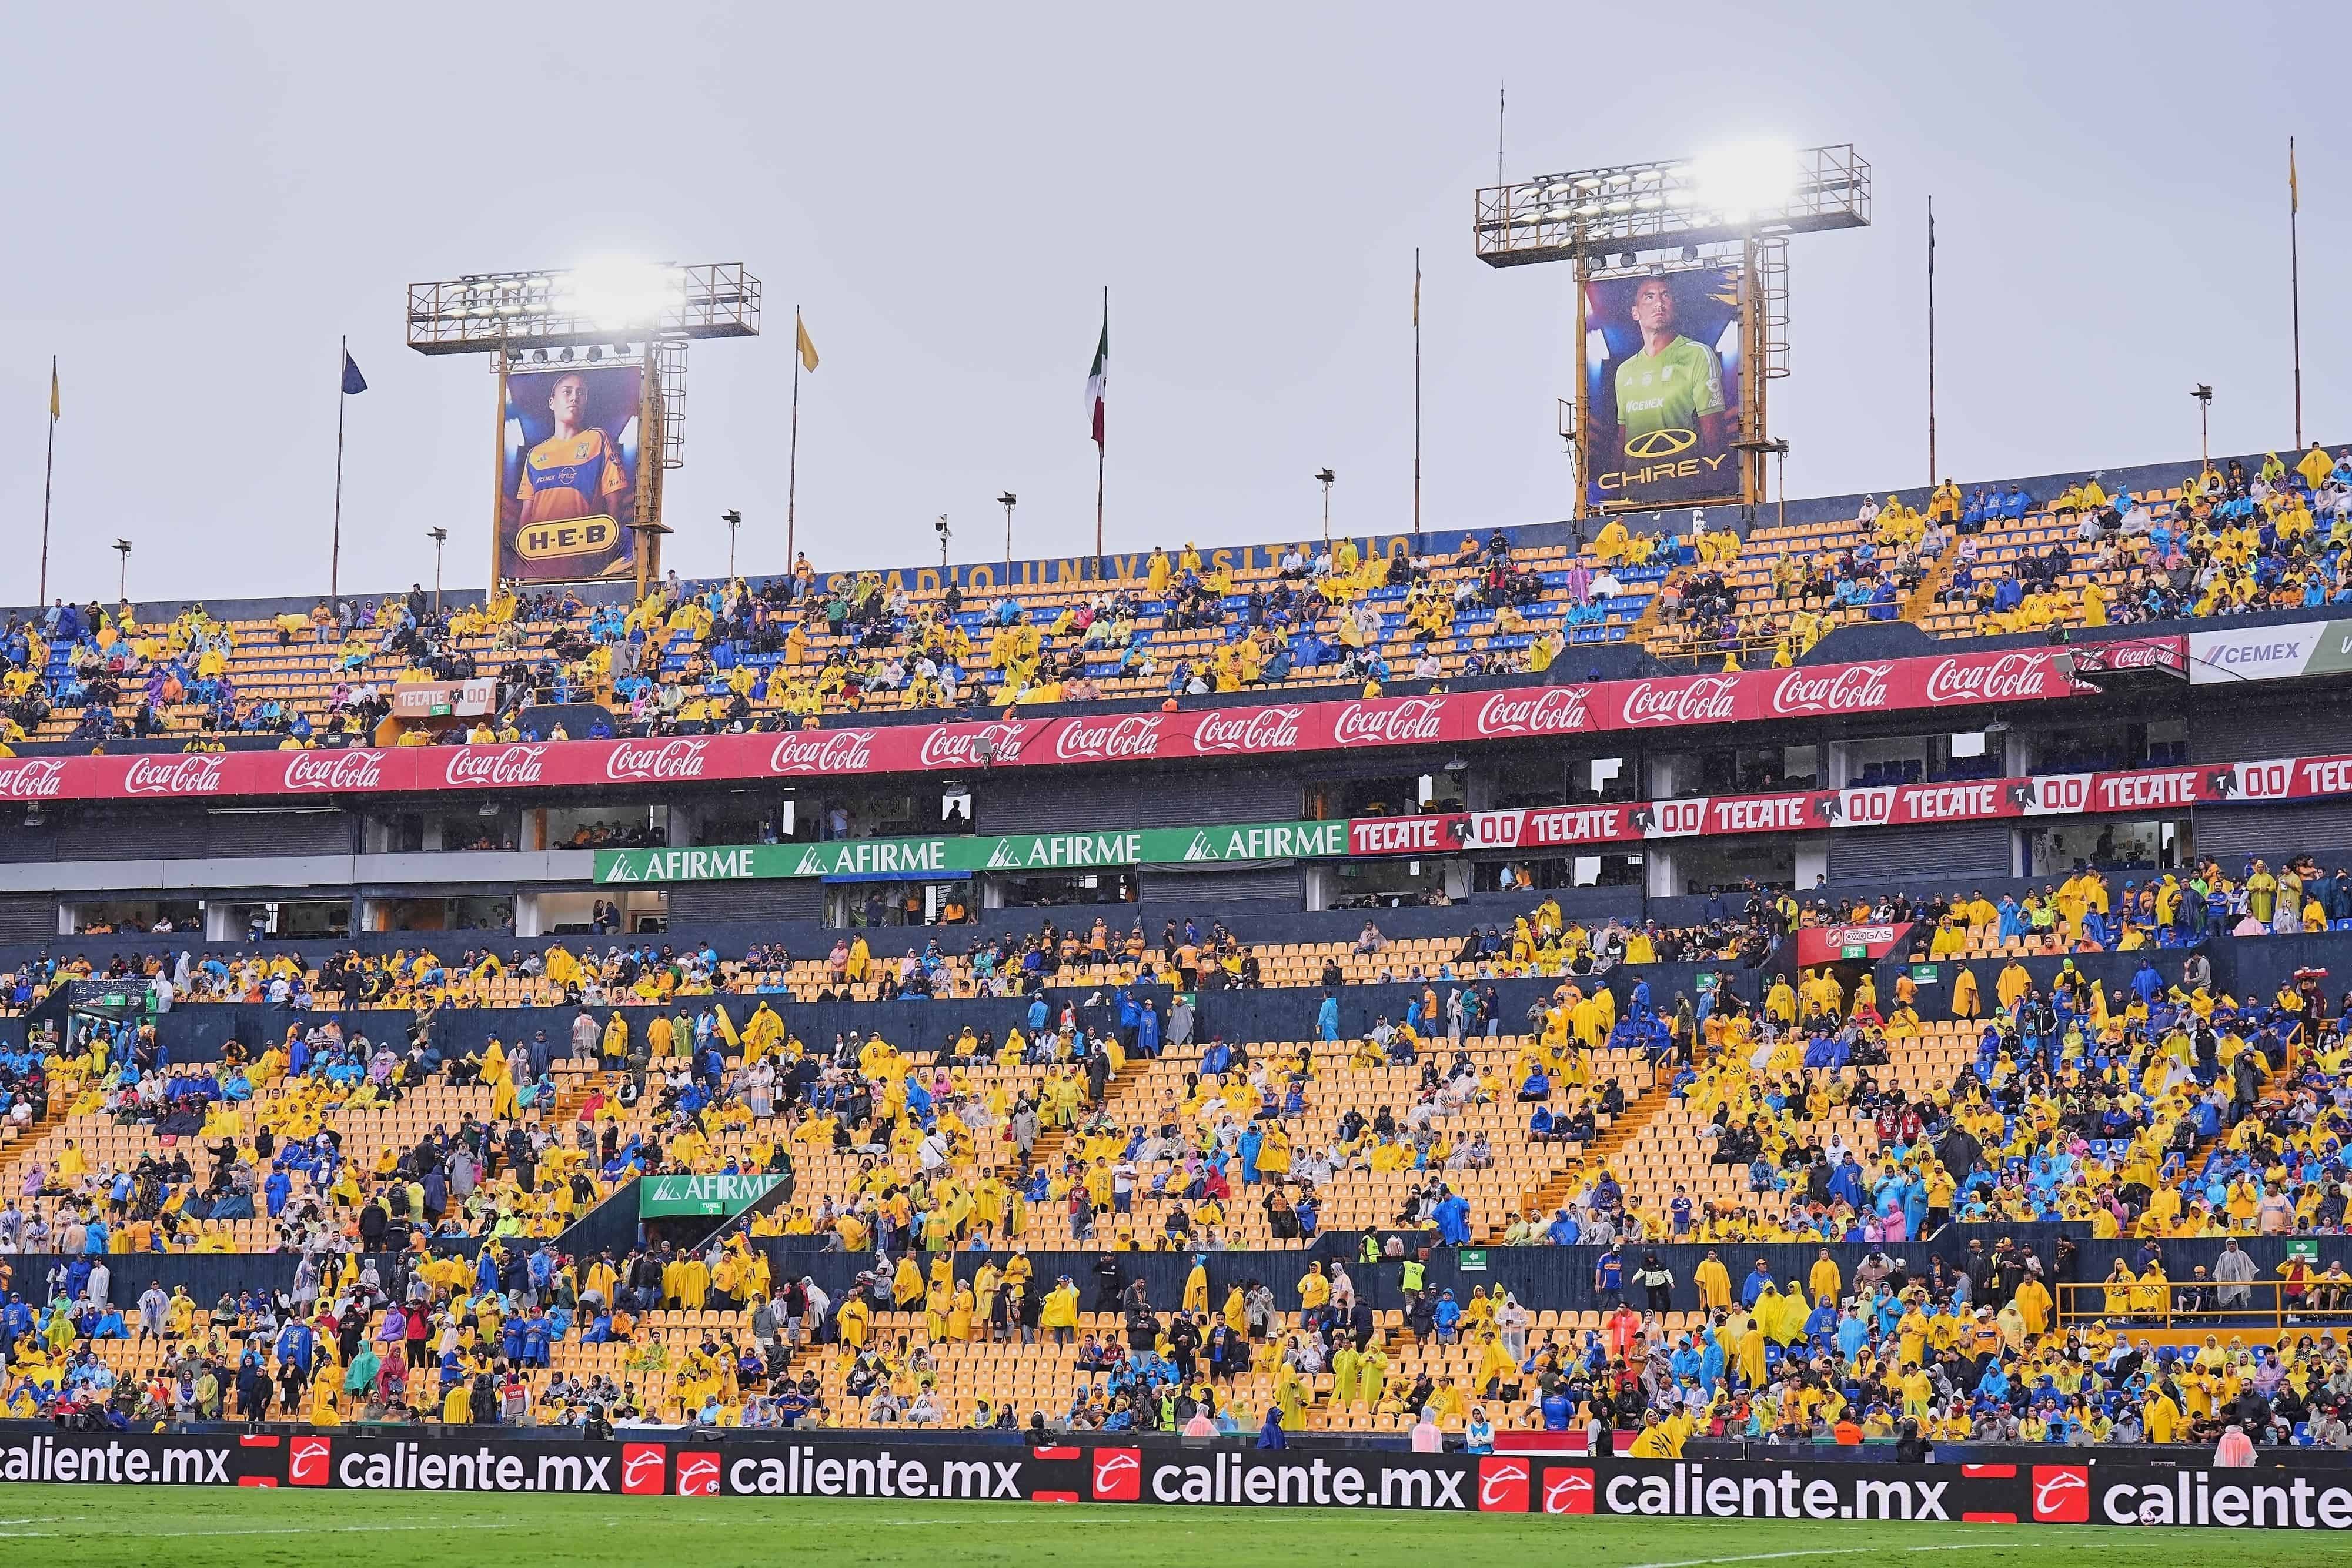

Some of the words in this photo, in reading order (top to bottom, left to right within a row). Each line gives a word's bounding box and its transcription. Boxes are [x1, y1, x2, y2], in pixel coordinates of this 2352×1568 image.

[1633, 398, 1663, 411] CEMEX
[1598, 454, 1726, 489] CHIREY
[529, 525, 606, 550] H-E-B
[2225, 643, 2300, 664] CEMEX
[1773, 665, 1893, 713] Coca-Cola
[1927, 650, 2051, 701] Coca-Cola
[399, 690, 445, 706] TECATE
[468, 688, 486, 703] 0.0
[1478, 688, 1591, 734] Coca-Cola
[1623, 677, 1740, 723] Coca-Cola
[1057, 716, 1164, 759] Coca-Cola
[1194, 708, 1304, 751] Coca-Cola
[1335, 698, 1446, 743] Coca-Cola
[285, 751, 385, 788] Coca-Cola
[446, 745, 547, 784] Coca-Cola
[607, 739, 710, 778] Coca-Cola
[771, 731, 876, 771] Coca-Cola
[0, 760, 67, 797] a-Cola
[125, 754, 226, 793] Coca-Cola
[2100, 772, 2197, 807] TECATE
[2246, 766, 2284, 796] 0.0
[1715, 798, 1806, 829] TECATE
[1850, 793, 1886, 822] 0.0
[1903, 785, 1997, 818] TECATE
[2044, 780, 2082, 808] 0.0
[1225, 825, 1341, 859] AFIRME
[1354, 820, 1438, 850] TECATE
[1481, 817, 1515, 843] 0.0
[1531, 810, 1619, 841] TECATE
[1663, 804, 1698, 832] 0.0
[644, 850, 753, 880] AFIRME
[834, 842, 944, 873] AFIRME
[1027, 834, 1141, 867] AFIRME
[0, 1436, 230, 1482] aliente.mx
[340, 1443, 611, 1490] caliente.mx
[730, 1447, 1021, 1497] caliente.mx
[1153, 1453, 1465, 1507] caliente.mx
[1606, 1463, 1949, 1520] caliente.mx
[2104, 1471, 2352, 1527] caliente
